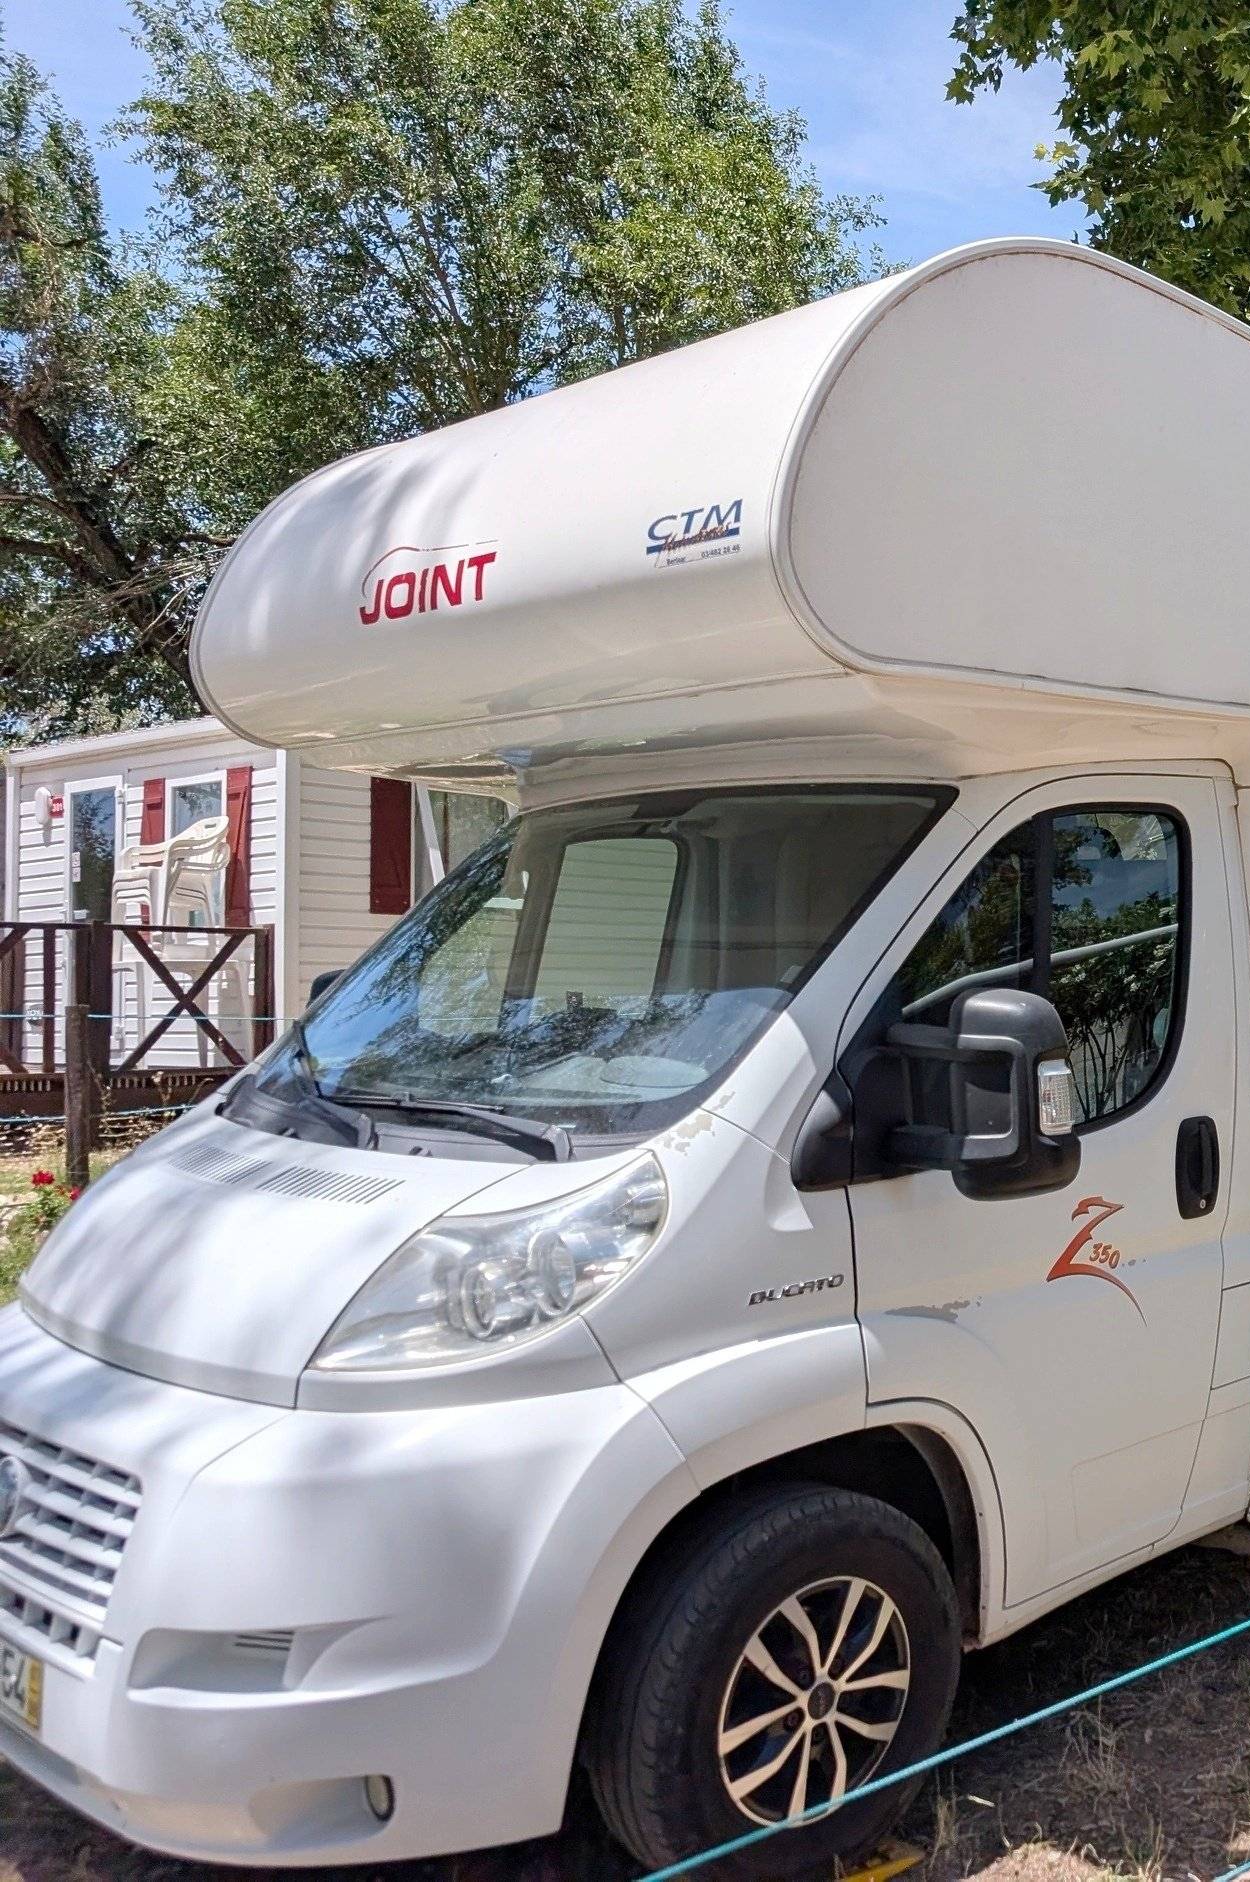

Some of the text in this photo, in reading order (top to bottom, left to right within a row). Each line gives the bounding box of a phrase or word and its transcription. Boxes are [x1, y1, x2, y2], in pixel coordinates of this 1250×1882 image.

[648, 498, 743, 540] CTM
[359, 551, 498, 625] JOINT
[1089, 1242, 1121, 1270] 350
[748, 1274, 845, 1306] DUCATO
